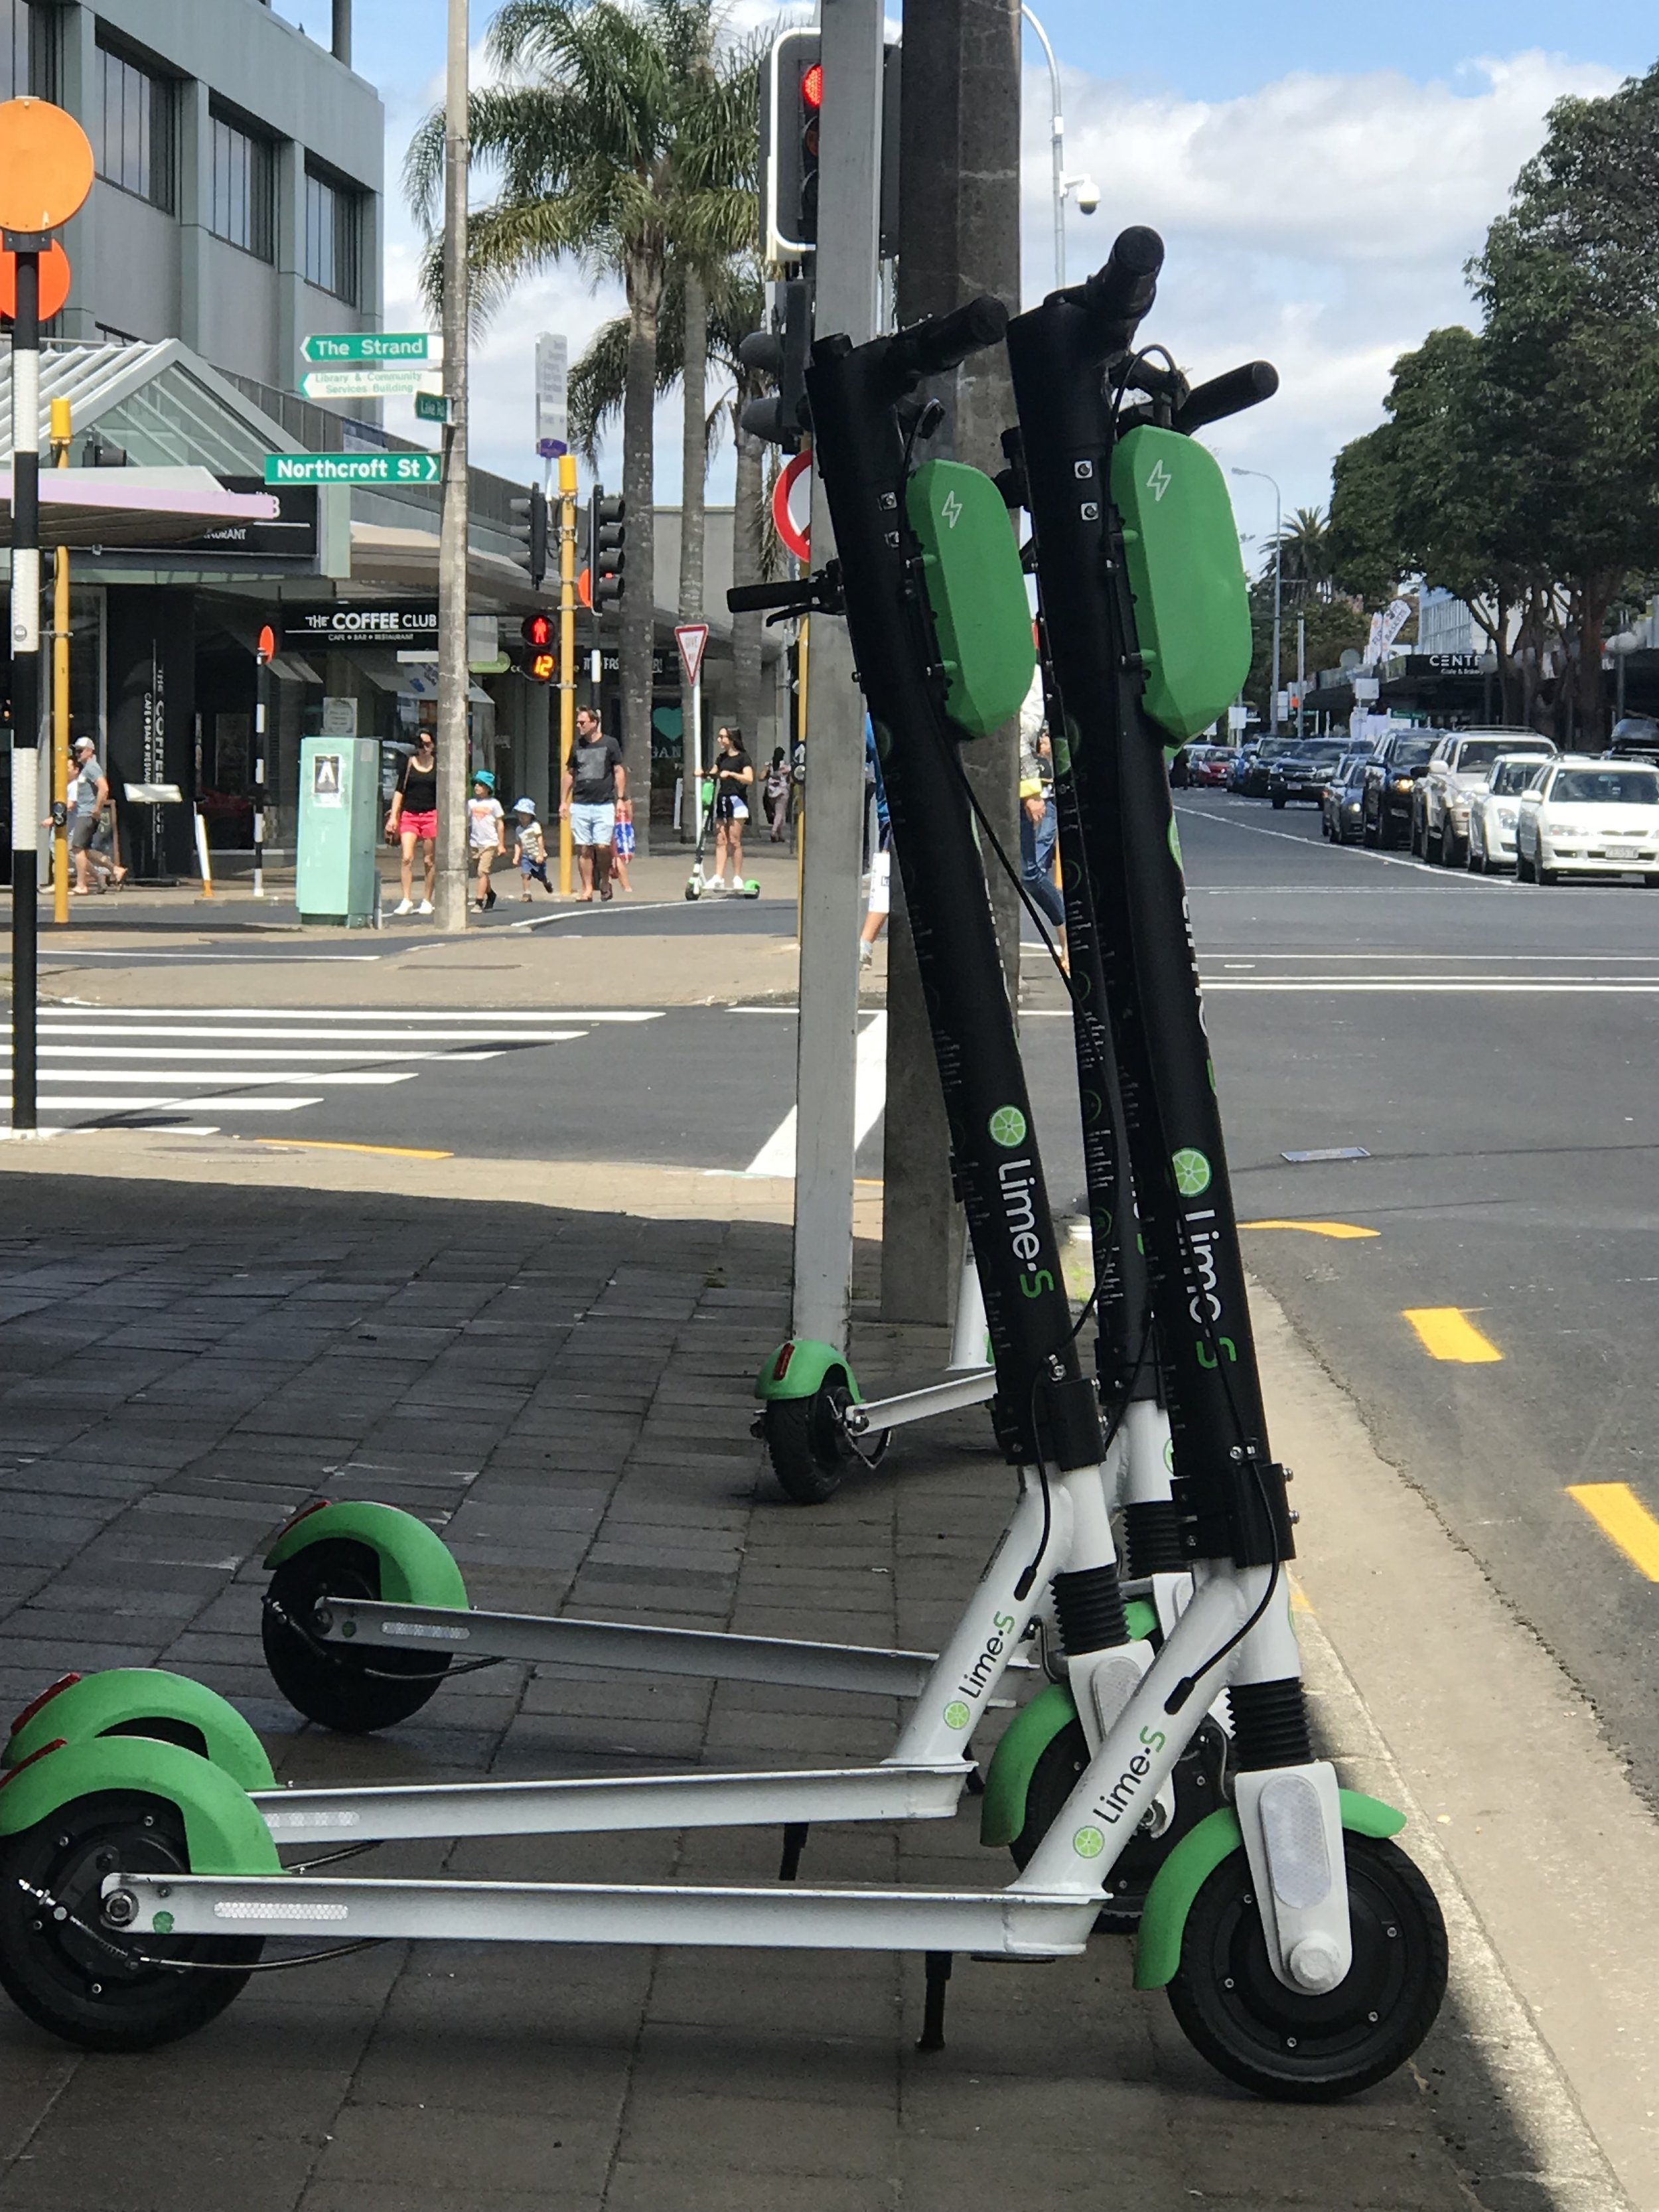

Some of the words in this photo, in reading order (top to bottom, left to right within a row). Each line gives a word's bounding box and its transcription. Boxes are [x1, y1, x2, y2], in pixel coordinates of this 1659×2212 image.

[316, 340, 350, 356] The
[361, 338, 423, 355] Strand
[315, 373, 349, 384] Library
[355, 373, 362, 382] &
[367, 371, 423, 382] Community
[326, 384, 368, 394] Services
[373, 382, 414, 394] Building
[277, 459, 388, 479] Northcroft
[397, 459, 421, 478] St
[305, 614, 330, 628] THE
[332, 612, 399, 630] COFFEE
[402, 614, 437, 627] CLUB
[534, 655, 554, 677] 12
